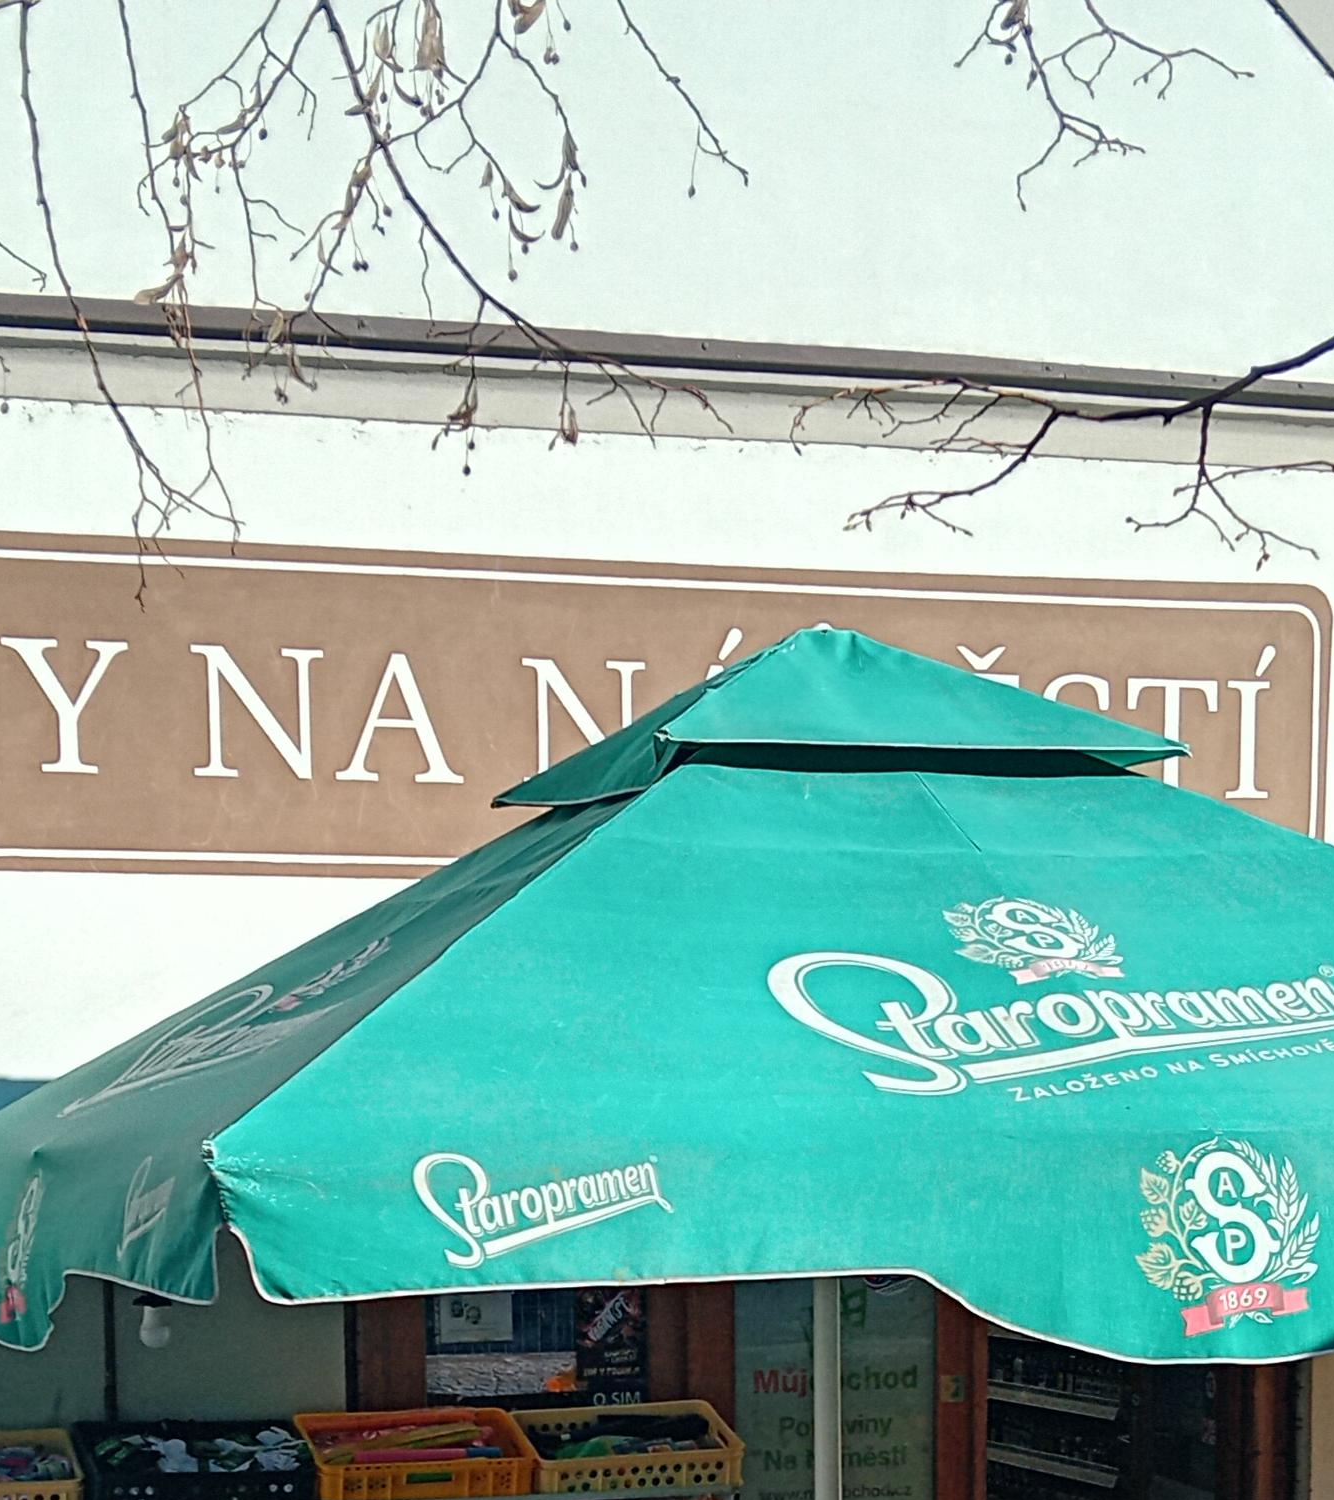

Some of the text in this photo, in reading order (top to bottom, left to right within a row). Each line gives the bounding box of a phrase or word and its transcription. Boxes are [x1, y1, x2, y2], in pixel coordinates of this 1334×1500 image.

[190, 644, 464, 784] NA
[412, 1152, 674, 1269] Staropramen
[1218, 1286, 1269, 1311] 1869
[753, 1364, 919, 1398] Můjchod
[779, 1413, 893, 1438] Poviny
